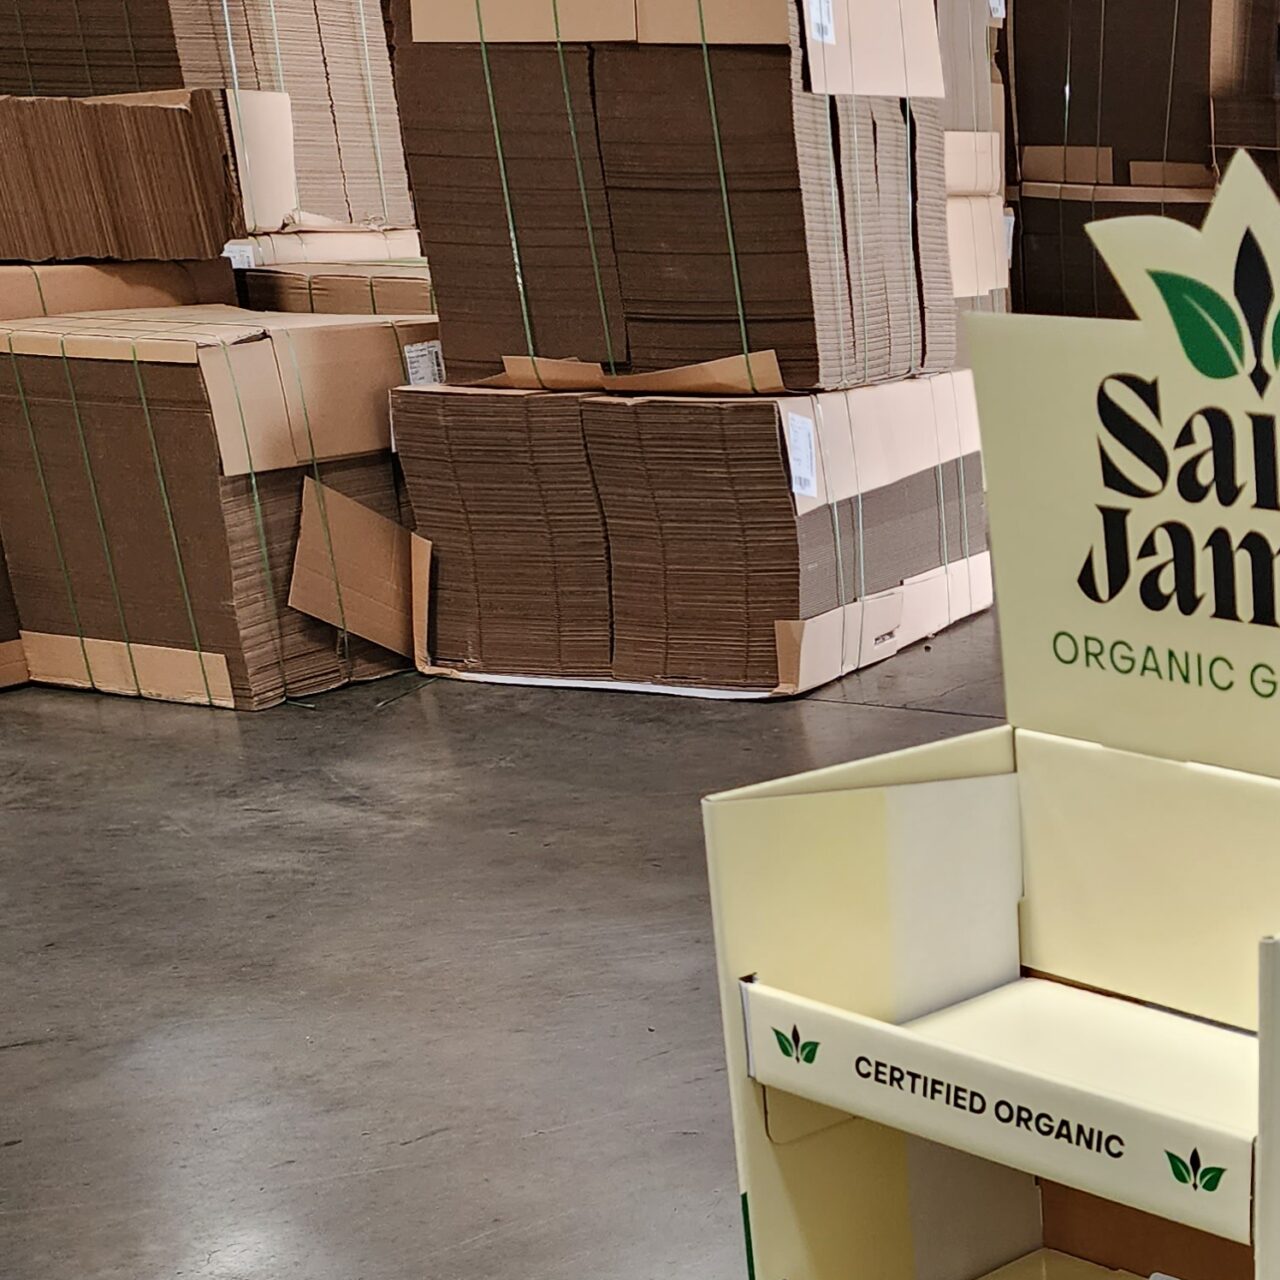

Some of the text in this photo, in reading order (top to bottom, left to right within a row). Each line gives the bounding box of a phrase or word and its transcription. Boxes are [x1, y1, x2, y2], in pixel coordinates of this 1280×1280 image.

[1052, 631, 1235, 692] ORGANIC
[854, 1056, 1125, 1159] CERTIFIED ORGANIC
